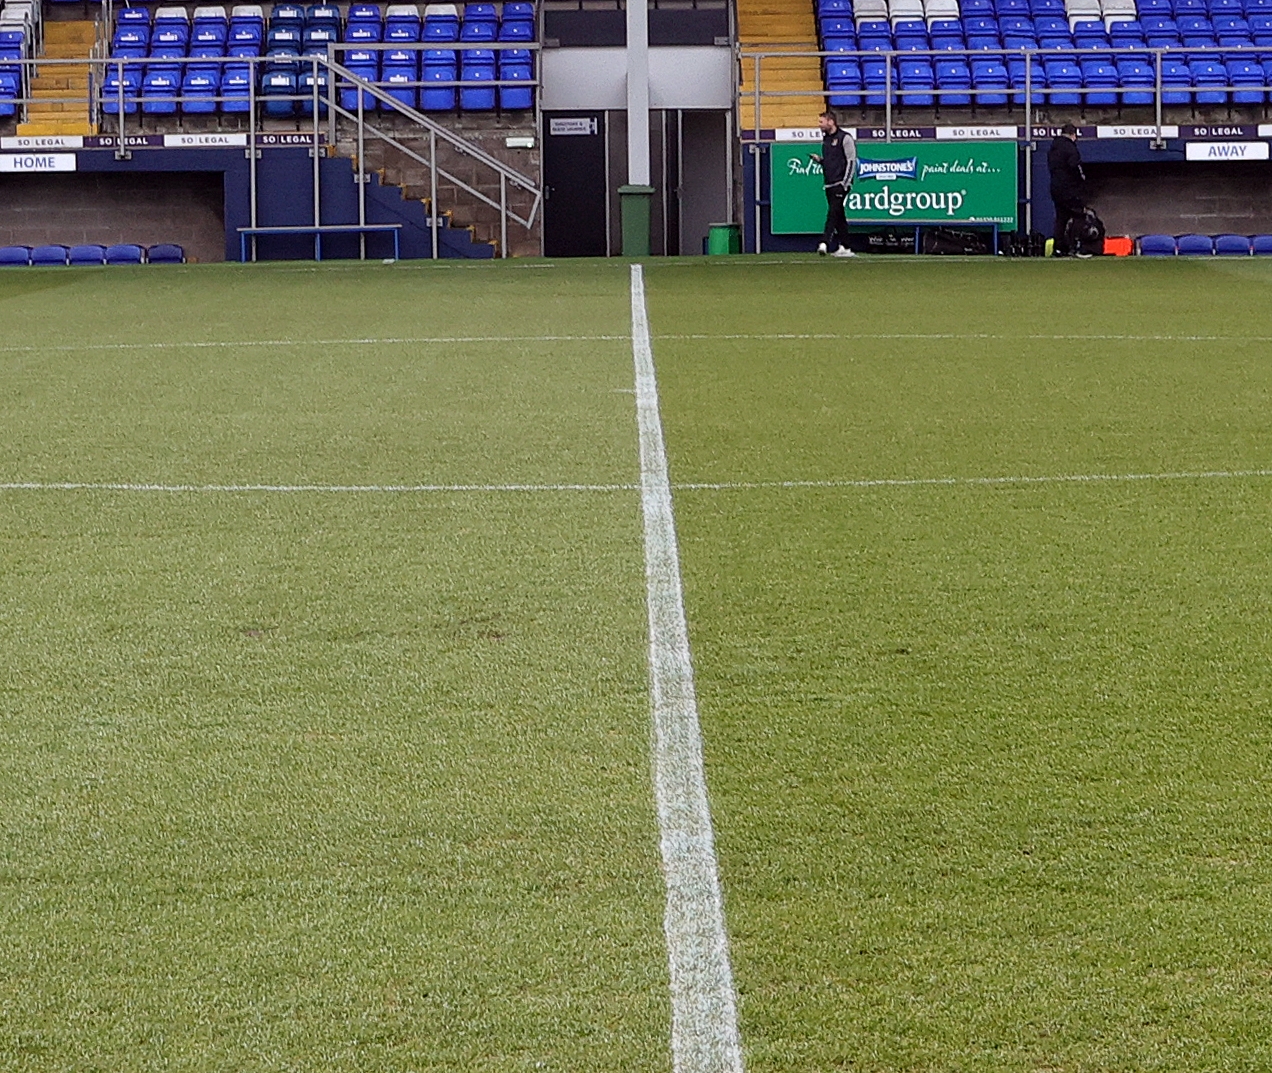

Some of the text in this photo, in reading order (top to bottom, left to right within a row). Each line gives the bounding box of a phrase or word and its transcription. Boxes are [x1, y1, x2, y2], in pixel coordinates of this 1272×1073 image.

[1194, 127, 1243, 135] SO LEGAL
[1208, 145, 1247, 157] AWAY
[13, 156, 55, 169] HOME
[921, 162, 948, 181] paint
[950, 158, 974, 174] deals
